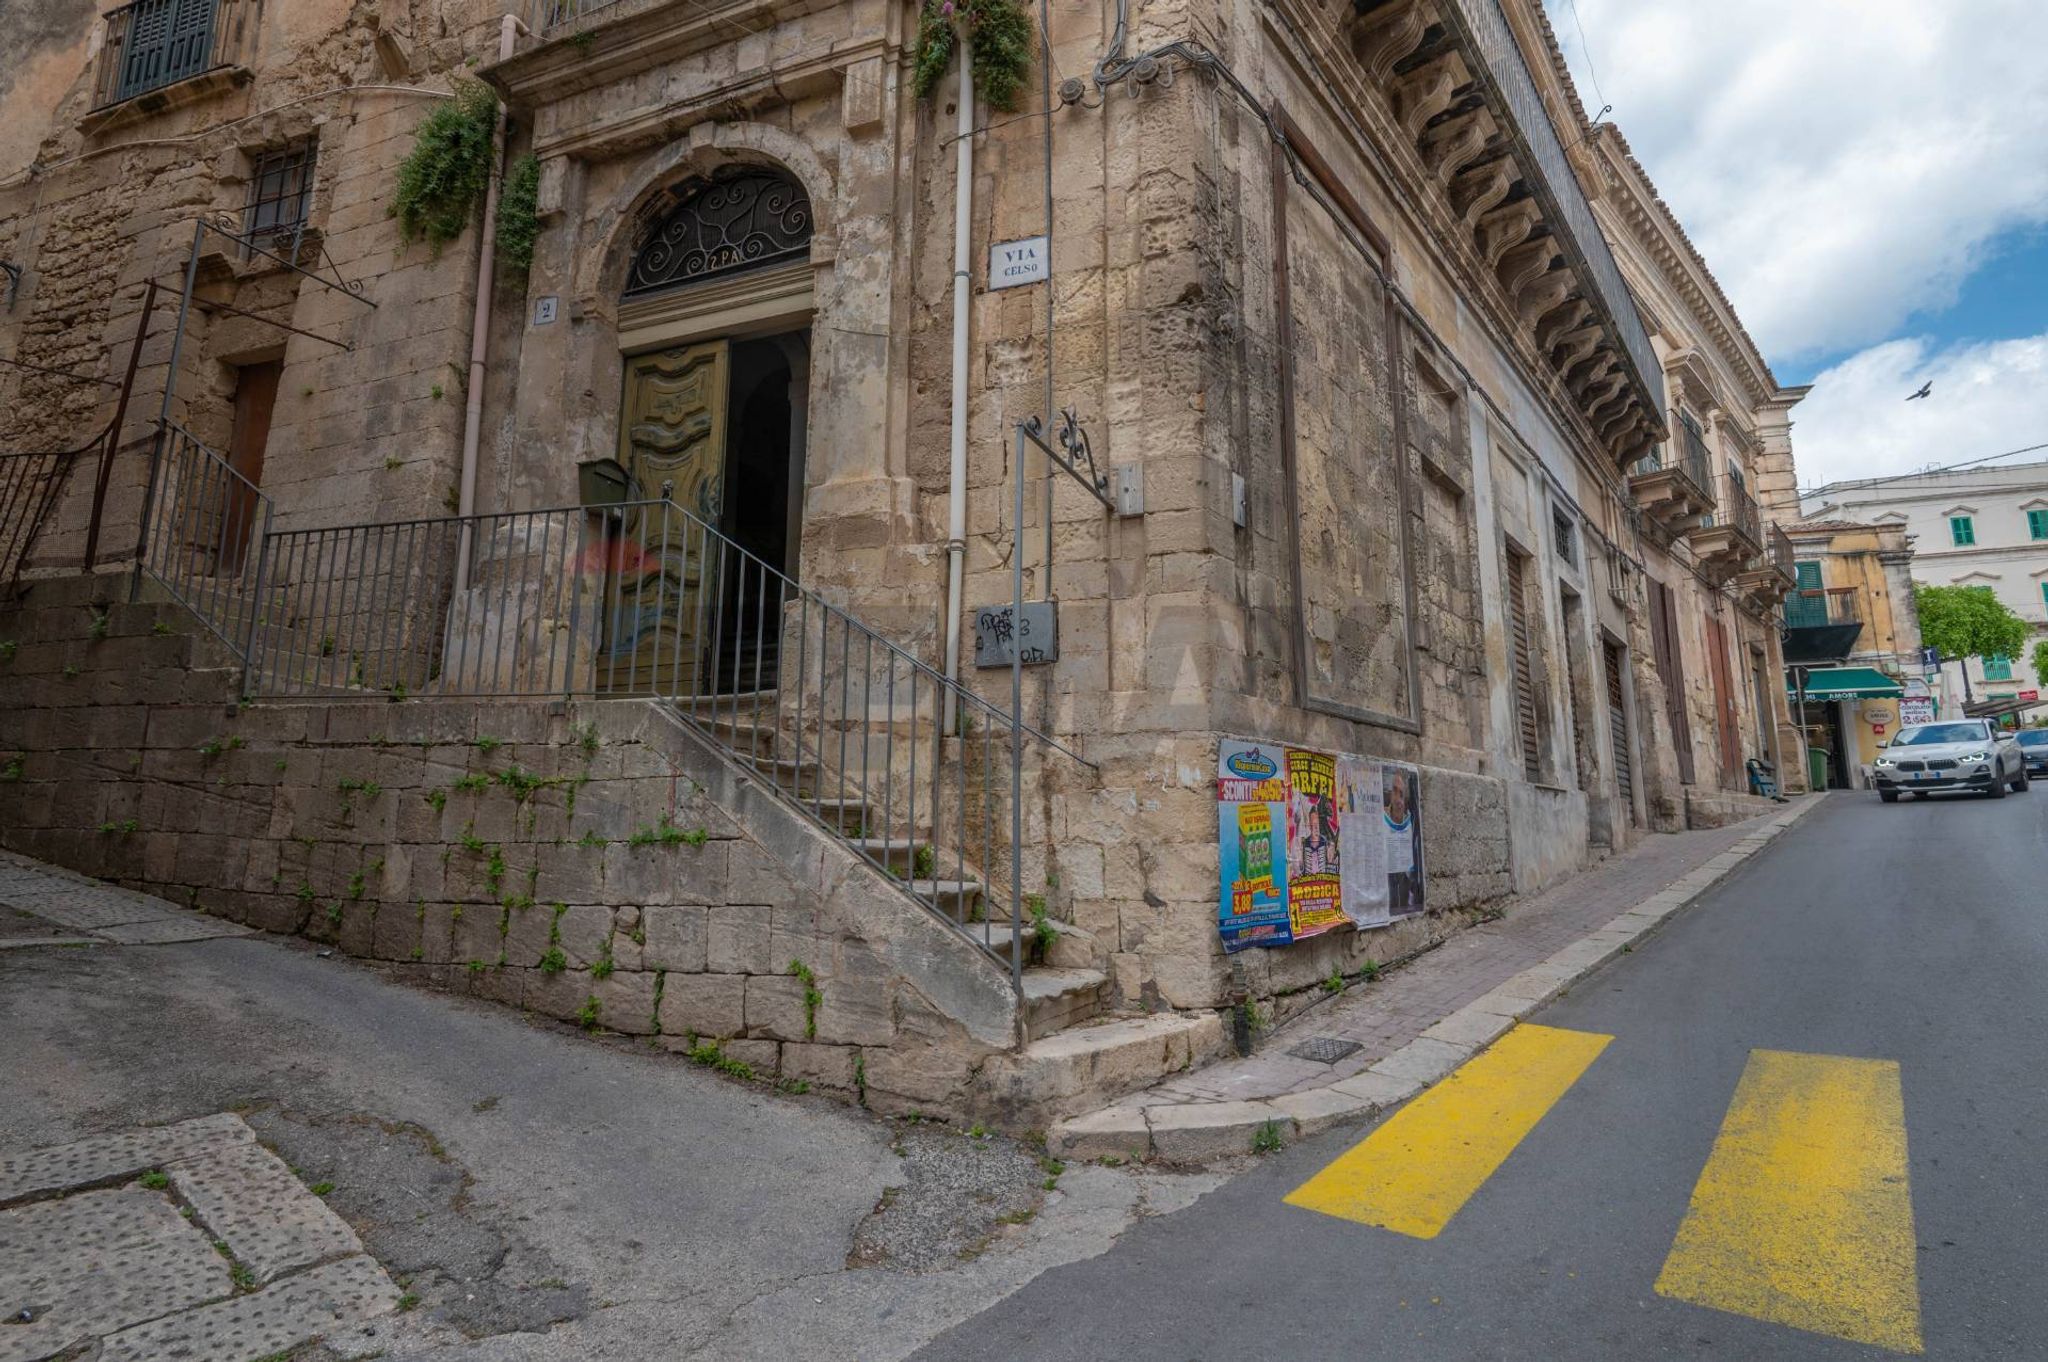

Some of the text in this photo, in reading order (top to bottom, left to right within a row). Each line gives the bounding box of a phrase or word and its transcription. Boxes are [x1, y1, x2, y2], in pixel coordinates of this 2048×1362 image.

[1005, 247, 1035, 262] VIA
[1004, 263, 1038, 277] CELSO
[543, 303, 550, 318] 2
[1223, 780, 1252, 801] SCONTI
[1290, 771, 1334, 799] ORFEI
[1291, 883, 1339, 900] MODICA
